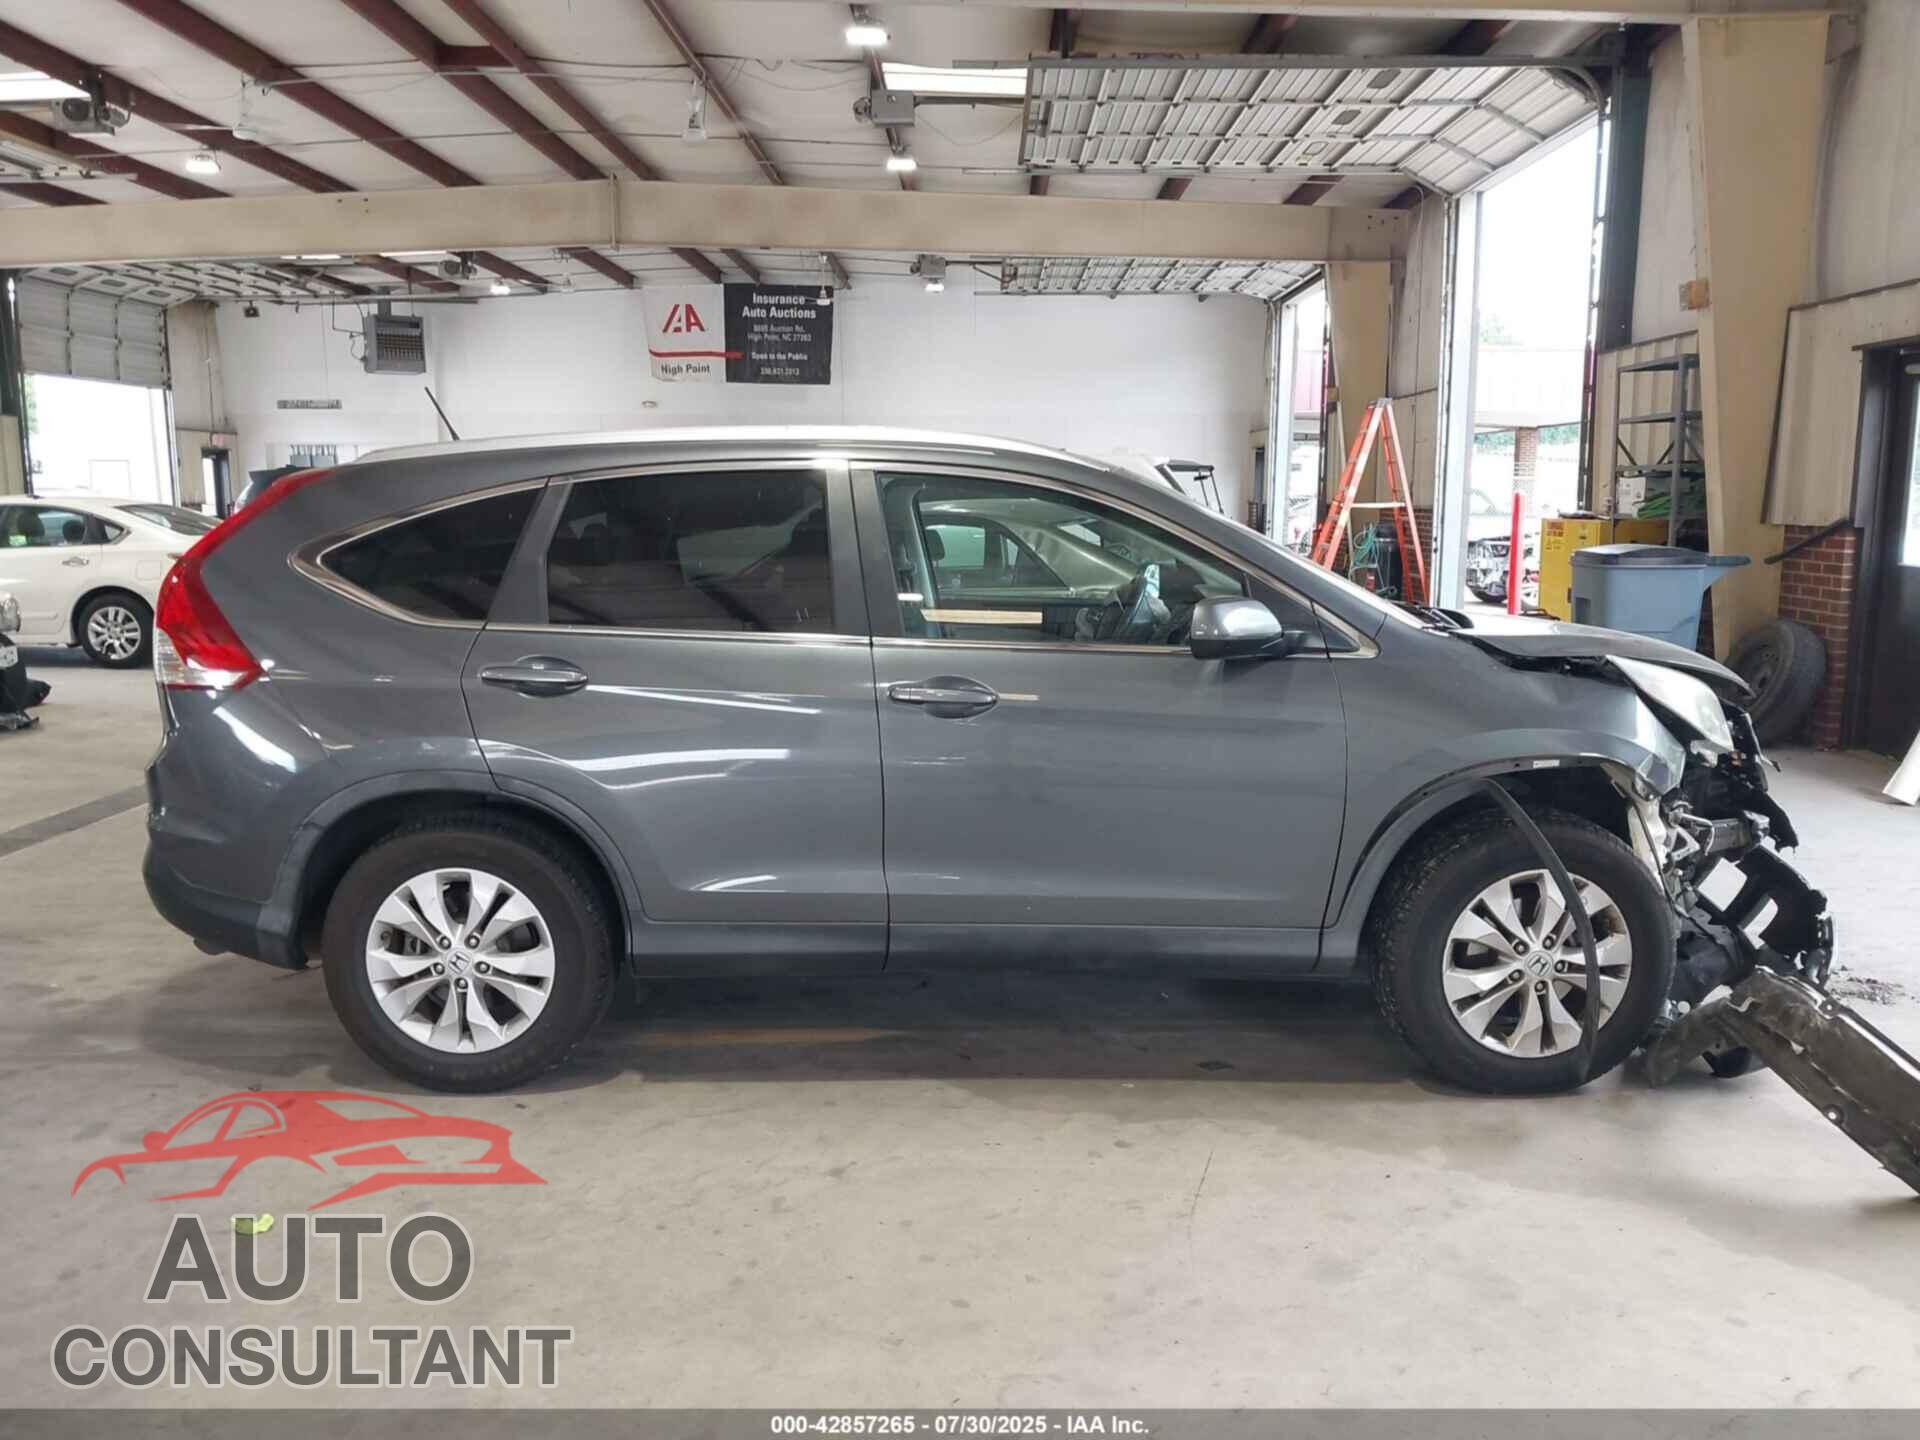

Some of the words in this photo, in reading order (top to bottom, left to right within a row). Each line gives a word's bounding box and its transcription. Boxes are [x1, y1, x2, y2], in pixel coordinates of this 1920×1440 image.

[753, 292, 805, 305] Insurance
[742, 305, 767, 318] Auto
[769, 306, 816, 319] Auctions
[661, 363, 683, 375] High
[686, 363, 710, 374] Point
